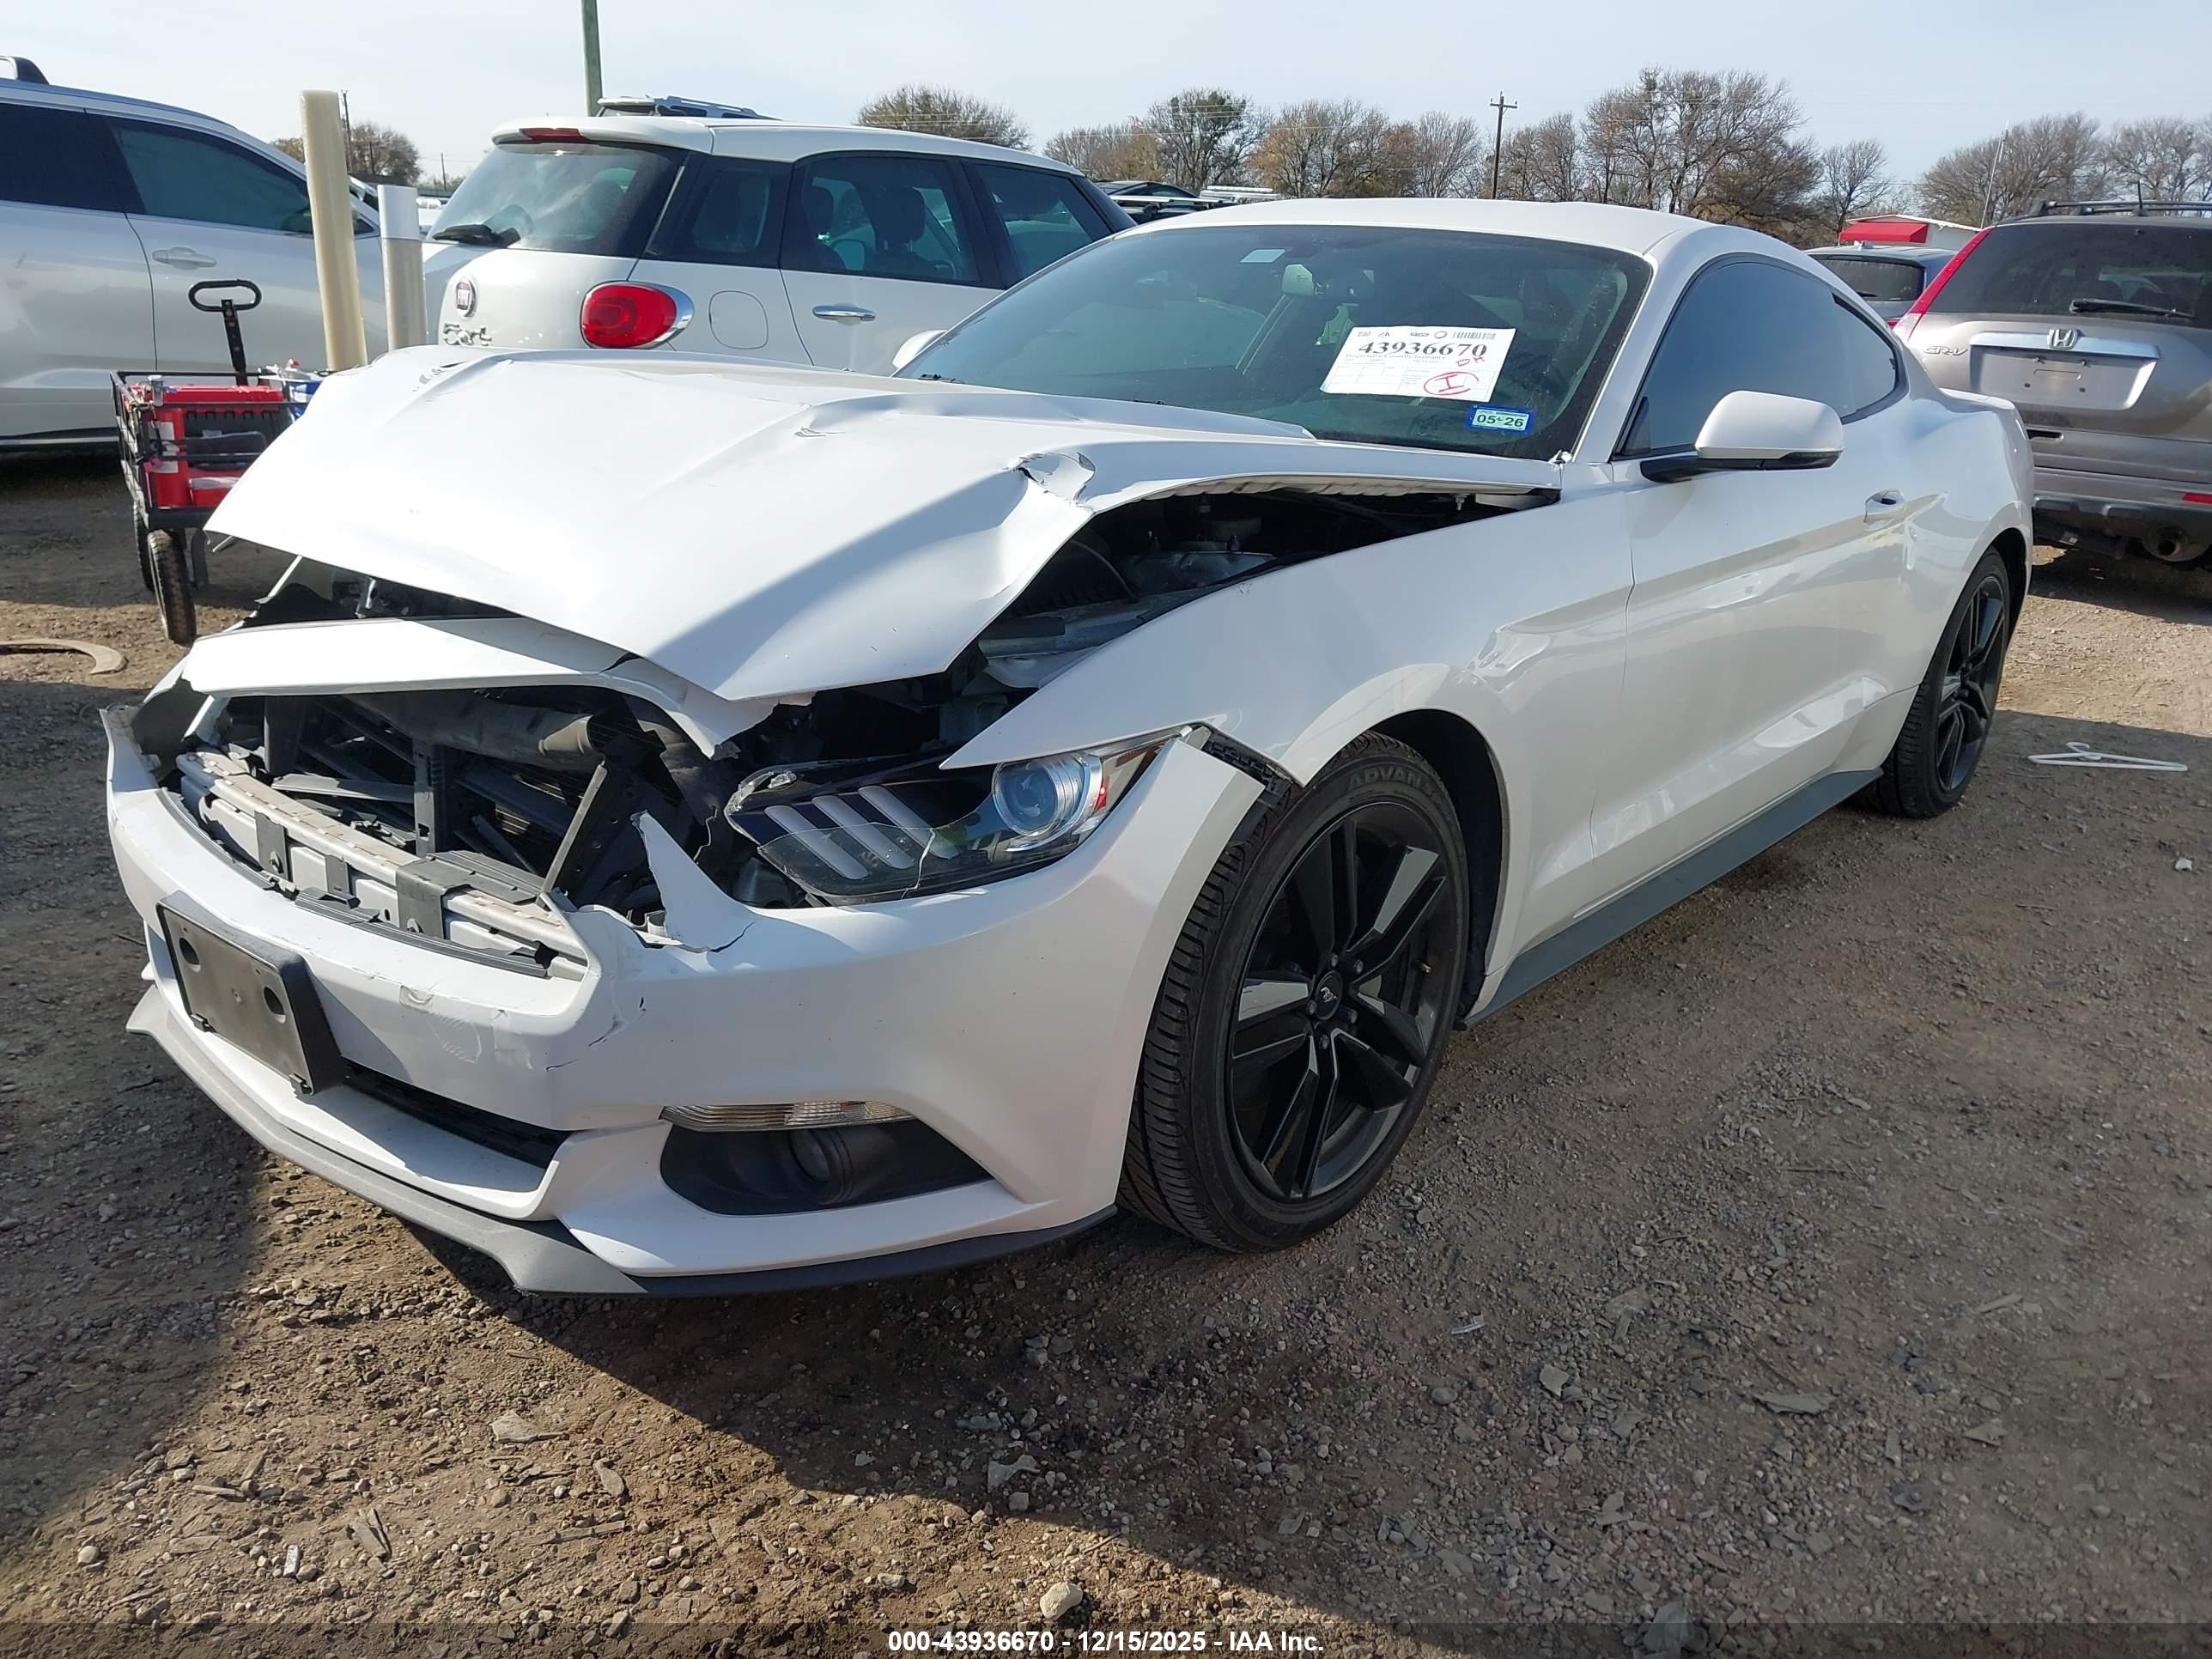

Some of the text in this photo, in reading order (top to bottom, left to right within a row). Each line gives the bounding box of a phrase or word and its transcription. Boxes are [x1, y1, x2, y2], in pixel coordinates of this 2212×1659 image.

[1358, 341, 1487, 356] 43936670
[1923, 345, 1969, 356] CR-V
[1476, 414, 1524, 428] 05 26
[1347, 765, 1422, 790] ADVAN
